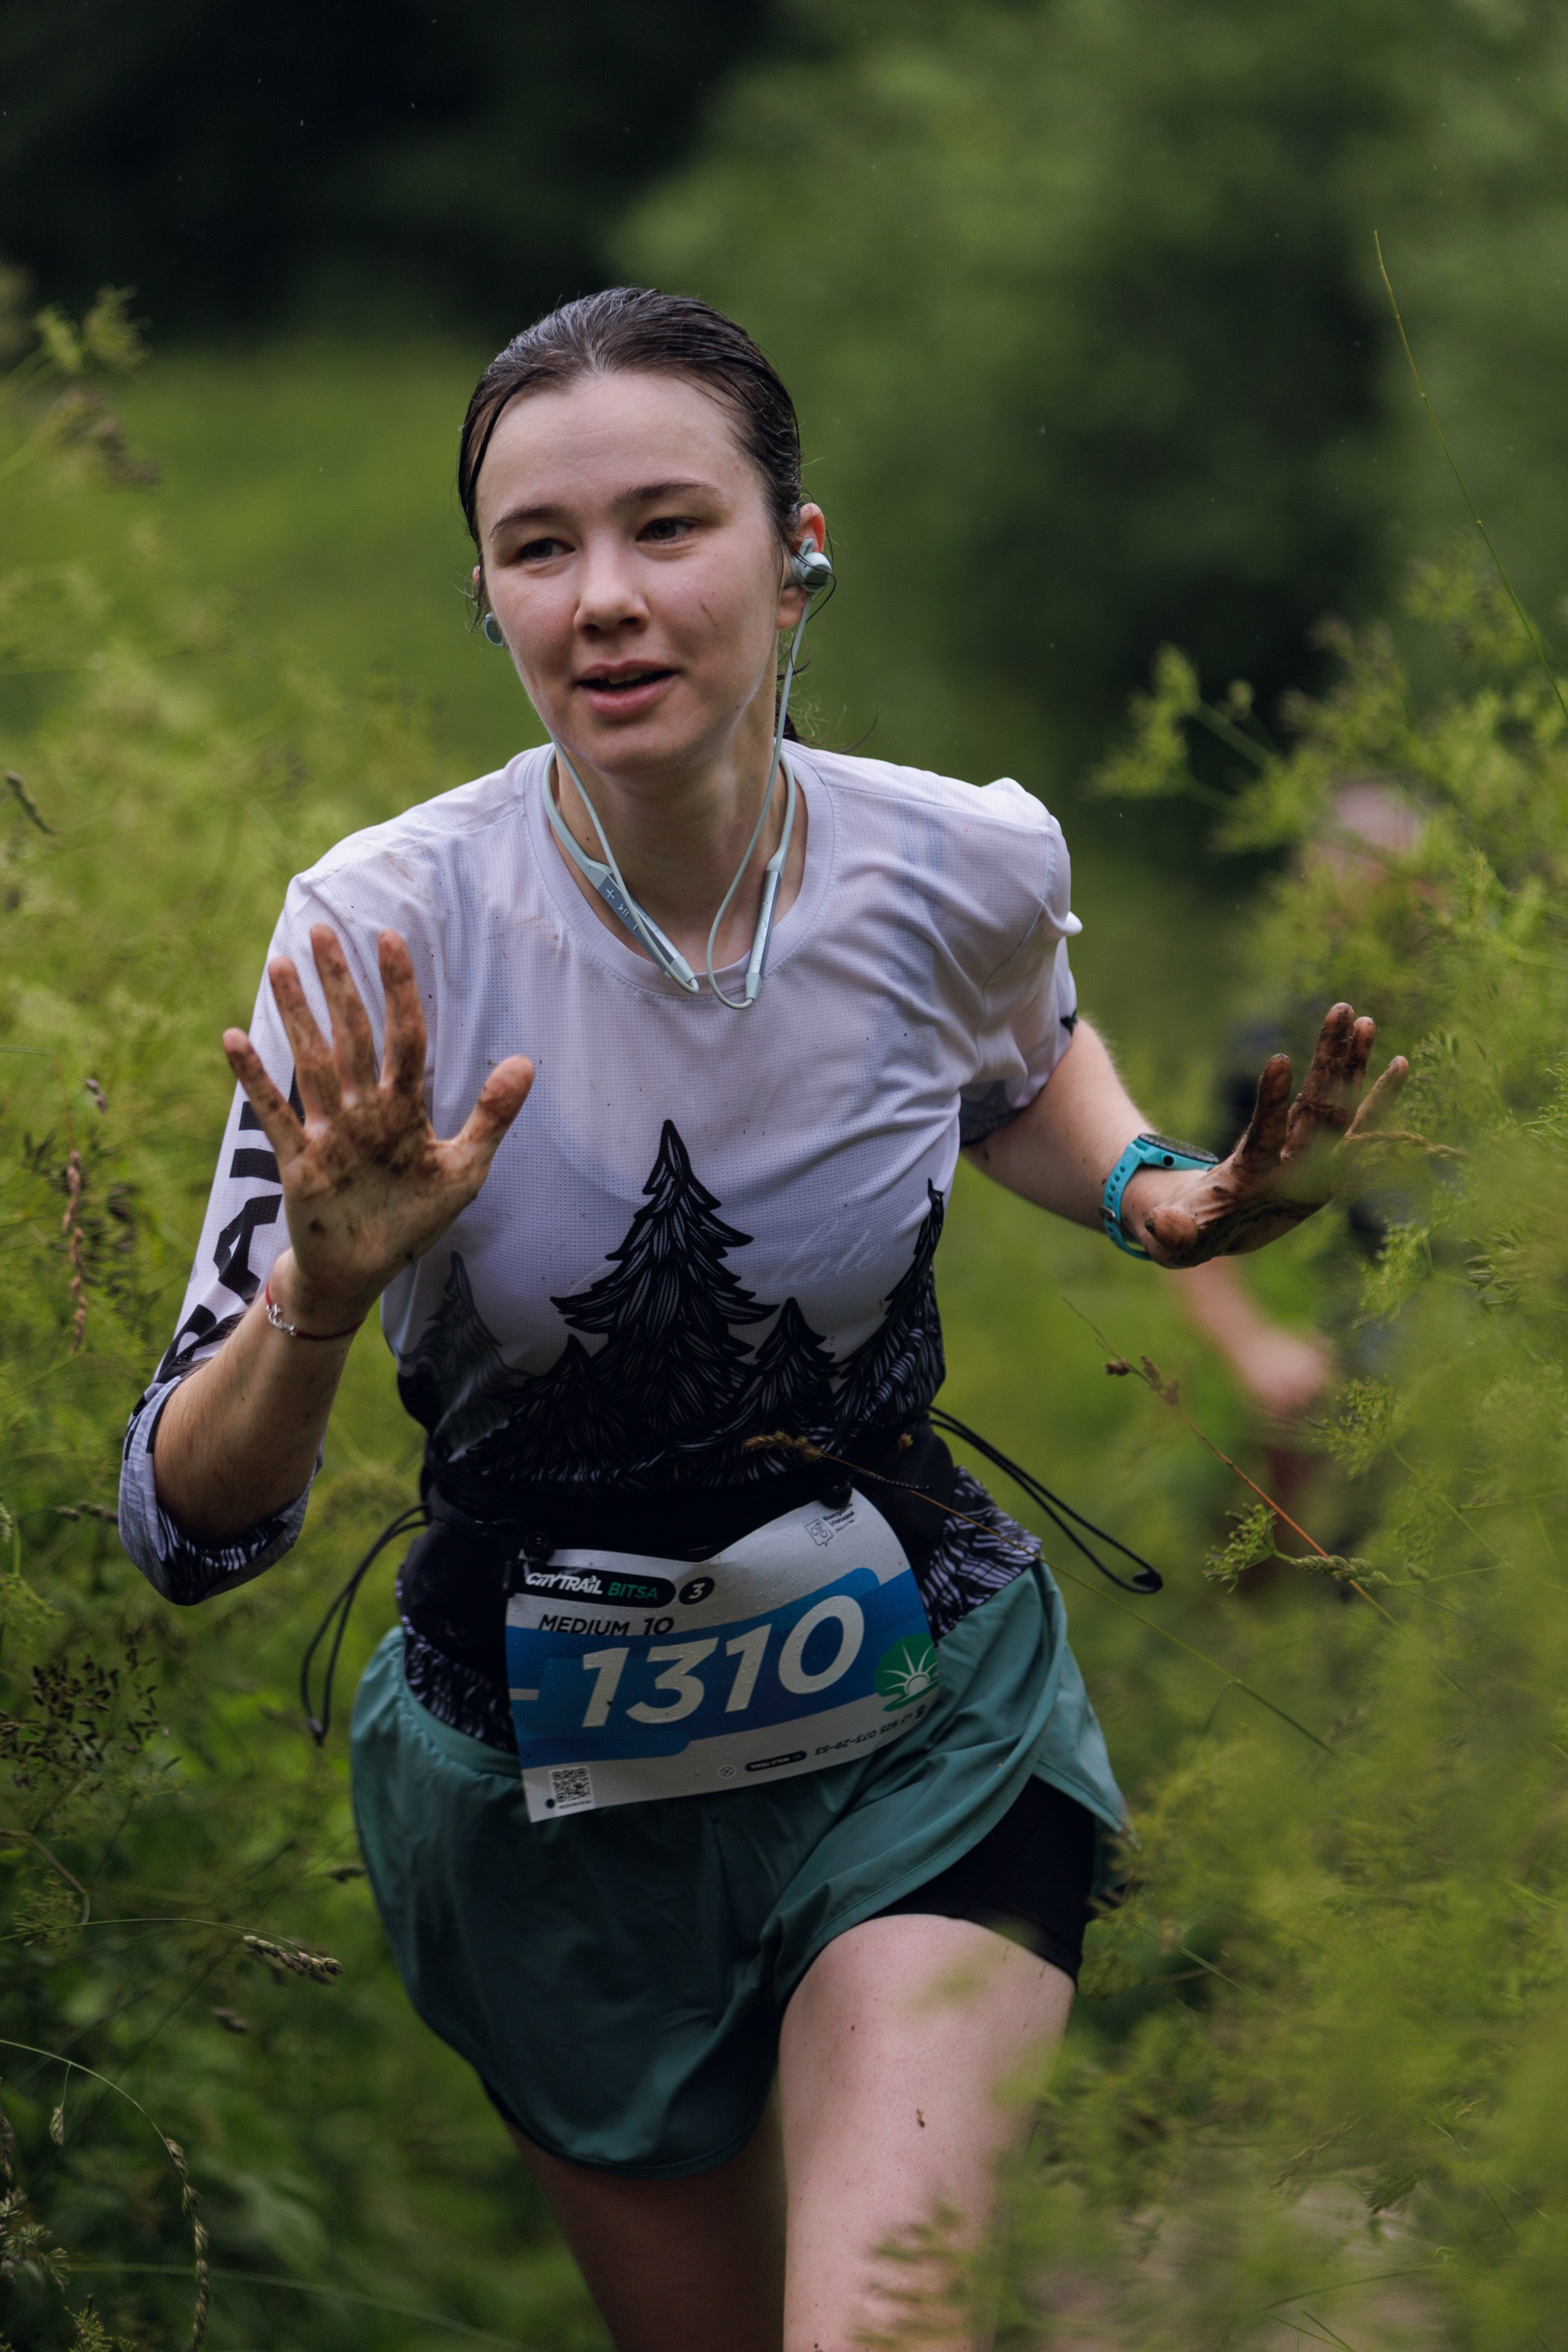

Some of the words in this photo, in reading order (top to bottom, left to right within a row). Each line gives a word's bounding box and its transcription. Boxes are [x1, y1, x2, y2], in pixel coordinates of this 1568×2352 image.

[607, 1582, 659, 1600] BITSA
[688, 1582, 706, 1600] 3
[537, 1613, 630, 1636] MEDIUM
[643, 1617, 675, 1636] 10
[581, 1595, 865, 1728] 1310
[813, 1730, 877, 1756] 073-29-53
